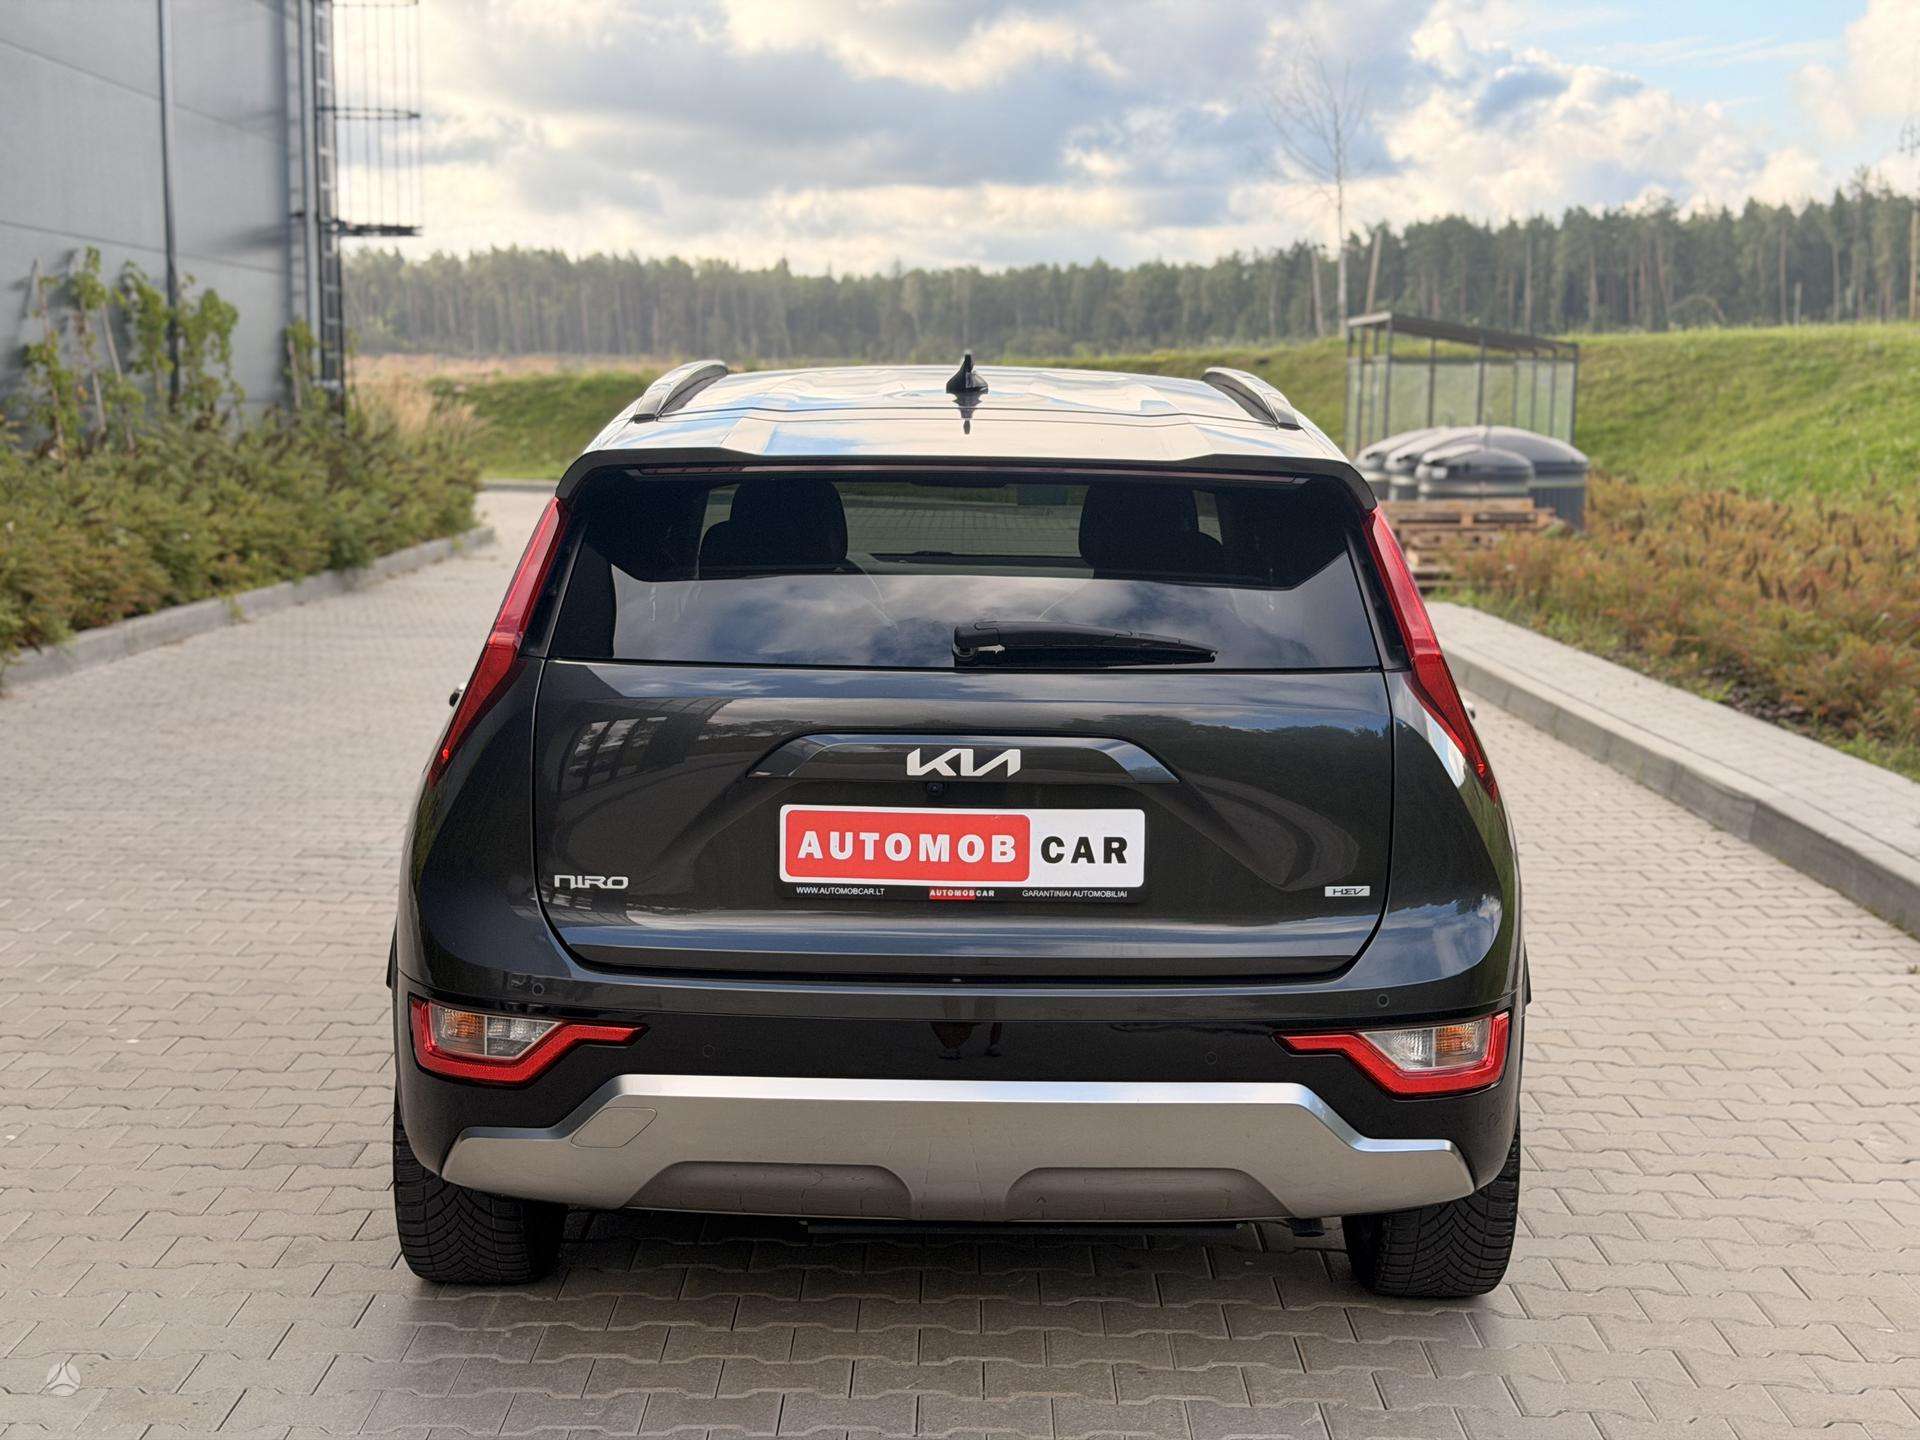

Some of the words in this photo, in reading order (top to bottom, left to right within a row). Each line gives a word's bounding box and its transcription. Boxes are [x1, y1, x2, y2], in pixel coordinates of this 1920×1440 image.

[906, 748, 1021, 777] KIA
[797, 830, 1016, 864] AUTOMOB
[1040, 836, 1128, 864] CAR
[554, 874, 629, 889] NIRO
[796, 886, 885, 896] WWW.AUTOMOBCAR.LT
[1022, 889, 1071, 898] GARANTINIAI
[1072, 890, 1128, 898] AUTOMOBILIAI
[1332, 888, 1364, 896] HEV
